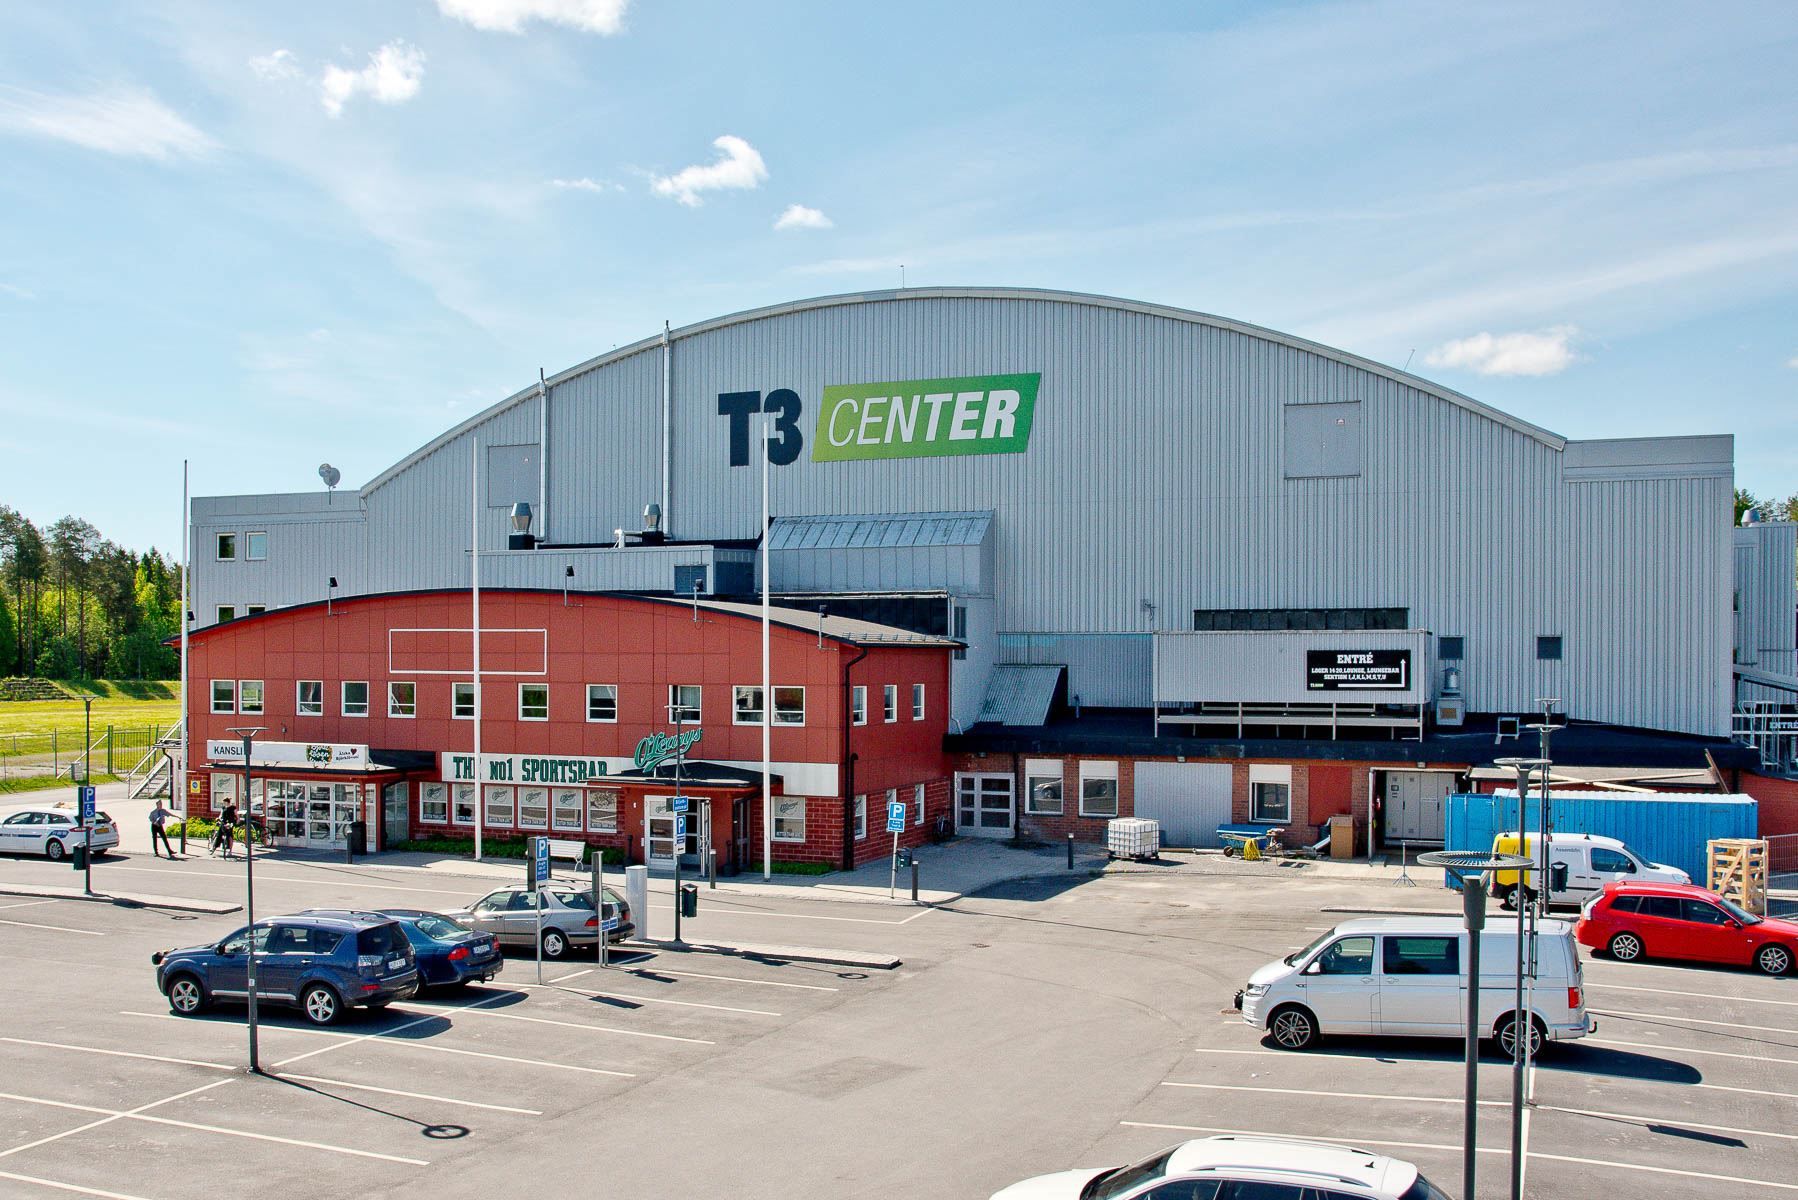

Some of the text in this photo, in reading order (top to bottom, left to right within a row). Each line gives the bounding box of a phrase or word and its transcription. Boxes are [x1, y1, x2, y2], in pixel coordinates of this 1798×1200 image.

[718, 388, 1020, 467] T3 CENTER
[1337, 651, 1373, 664] ENTRÉ
[214, 746, 243, 756] KANSLI
[521, 758, 608, 784] SPORTSBAR
[86, 788, 94, 801] P
[893, 804, 903, 818] P
[678, 817, 684, 834] P
[539, 840, 546, 857] P
